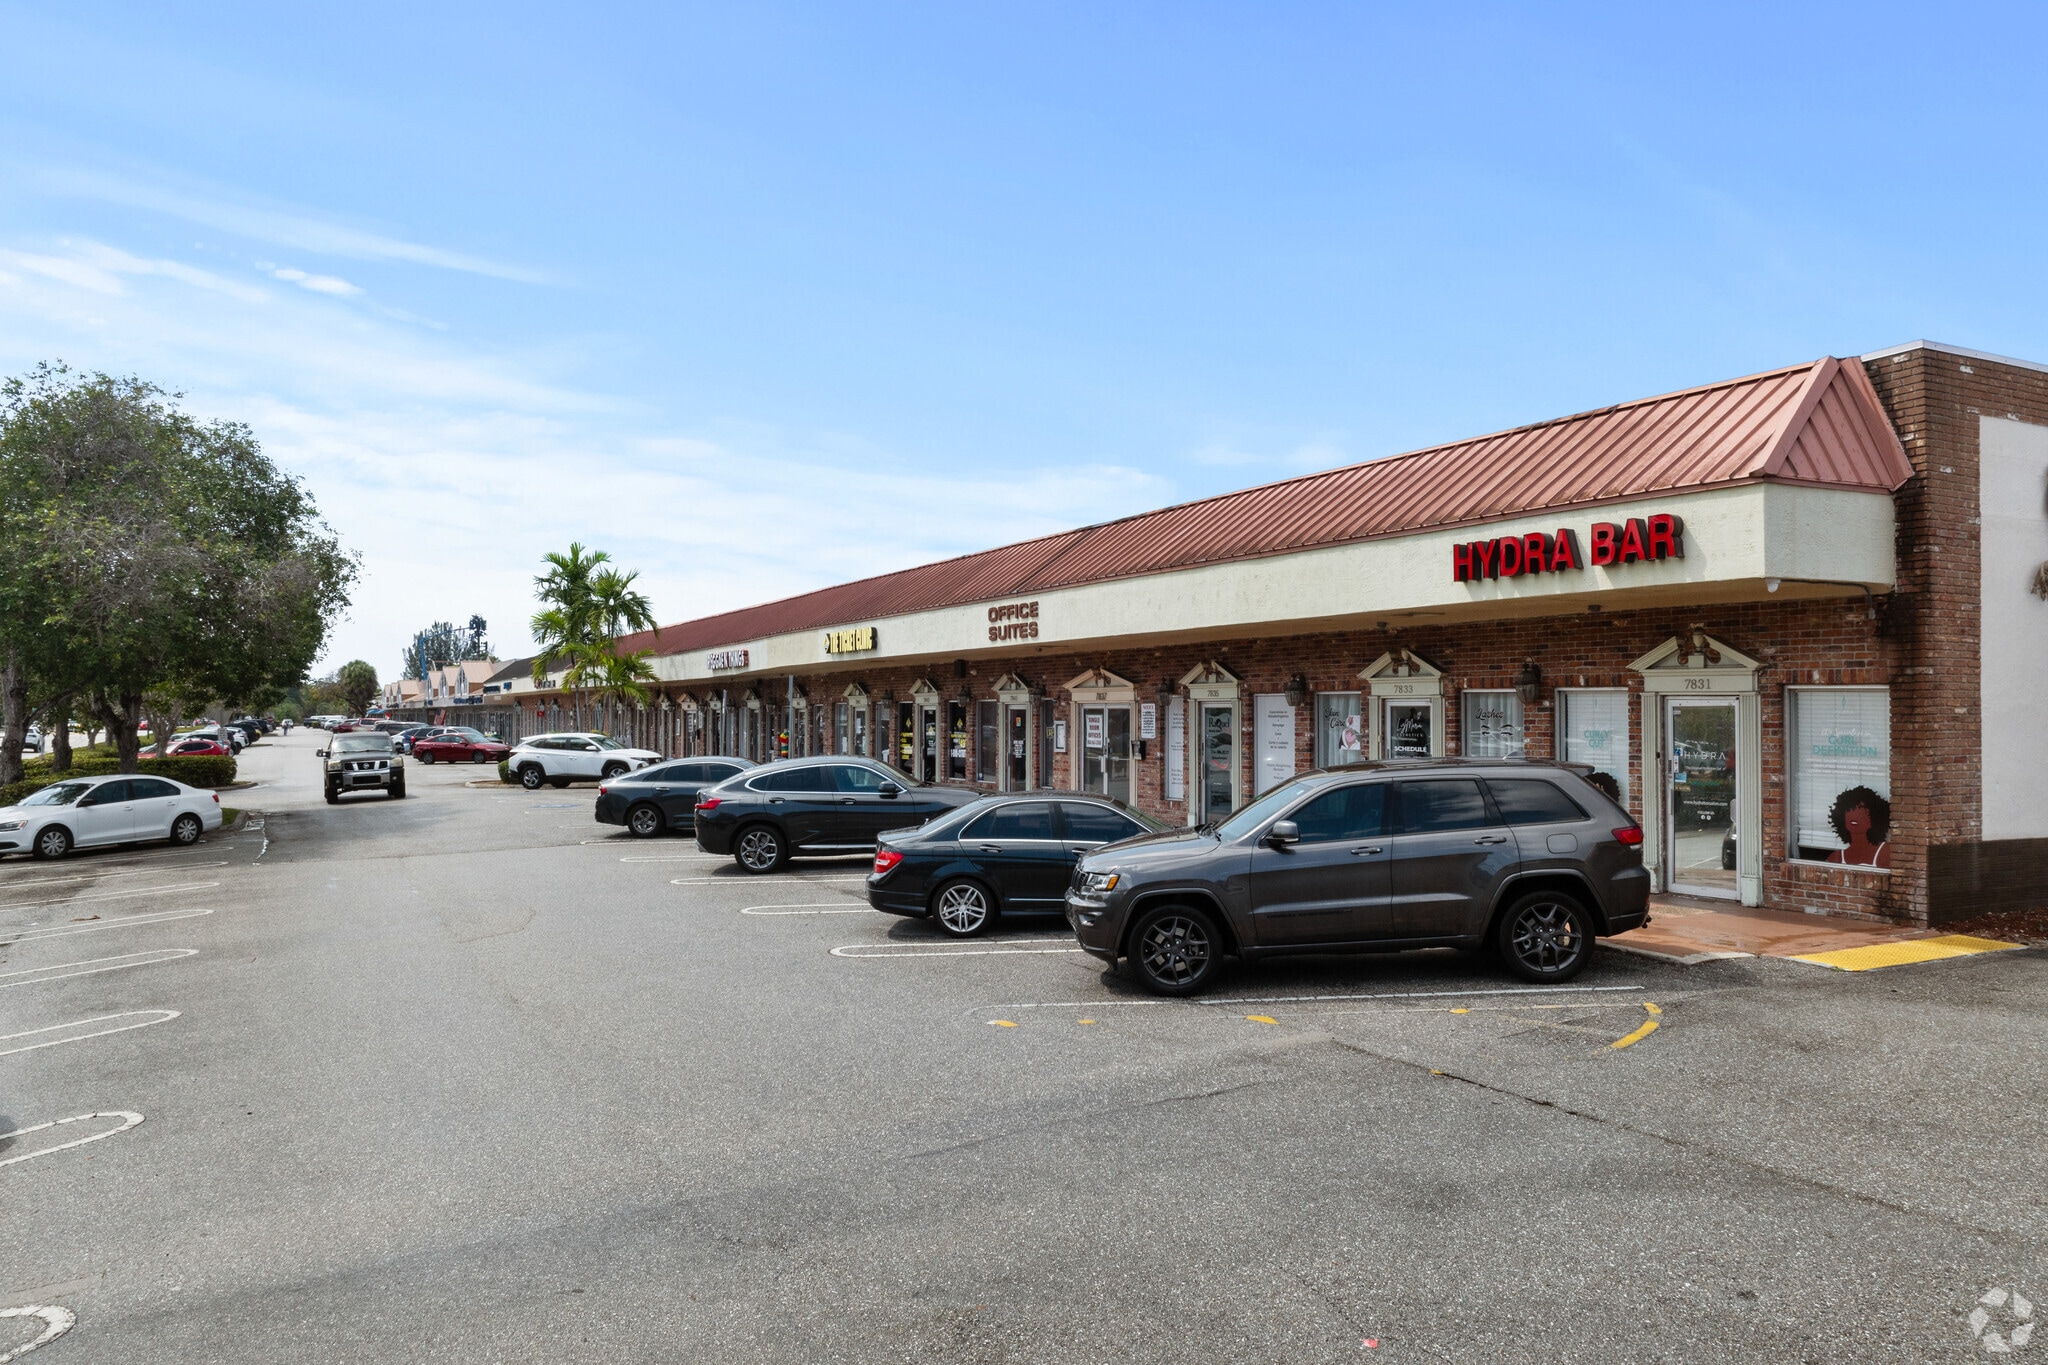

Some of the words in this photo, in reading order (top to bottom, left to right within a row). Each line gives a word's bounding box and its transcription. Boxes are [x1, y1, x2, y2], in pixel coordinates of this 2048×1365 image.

[1453, 528, 1584, 582] HYDRA
[1591, 513, 1685, 566] BAR
[988, 601, 1039, 622] OFFICE
[988, 621, 1039, 641] SUITES
[1394, 685, 1414, 694] 7833
[1684, 679, 1711, 690] 7831
[1324, 708, 1340, 718] Skin
[1475, 708, 1505, 720] Lashes
[1330, 718, 1346, 729] Care
[1583, 730, 1610, 739] CURLY
[1828, 735, 1858, 745] CURL
[1589, 740, 1605, 748] CUT
[1683, 751, 1726, 760] HYDRA
[1812, 745, 1878, 757] DEFINITION
